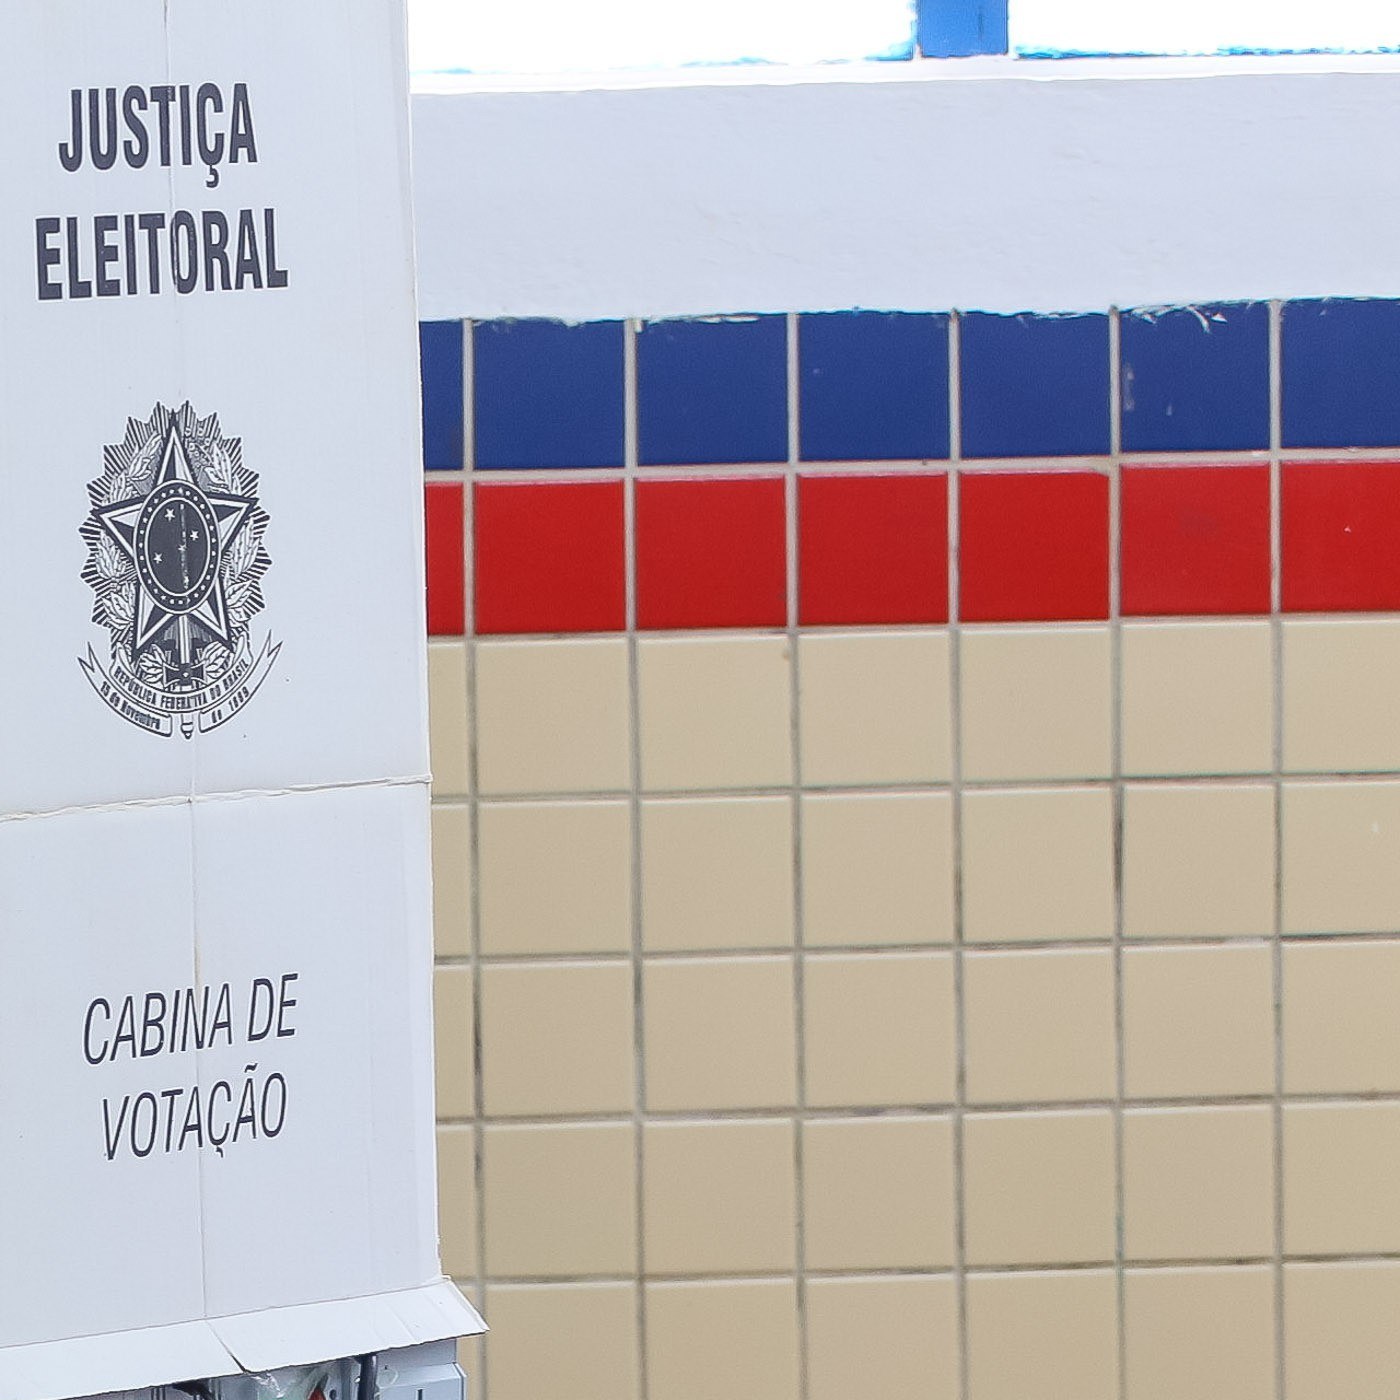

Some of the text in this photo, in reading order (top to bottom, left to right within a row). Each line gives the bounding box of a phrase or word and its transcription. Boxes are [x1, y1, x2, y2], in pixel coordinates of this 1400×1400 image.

[58, 82, 258, 188] JUSTIÇA
[35, 207, 289, 301] ELEITORAL
[83, 972, 299, 1065] CABINA DE
[102, 1062, 287, 1161] VOTAÇÃO
